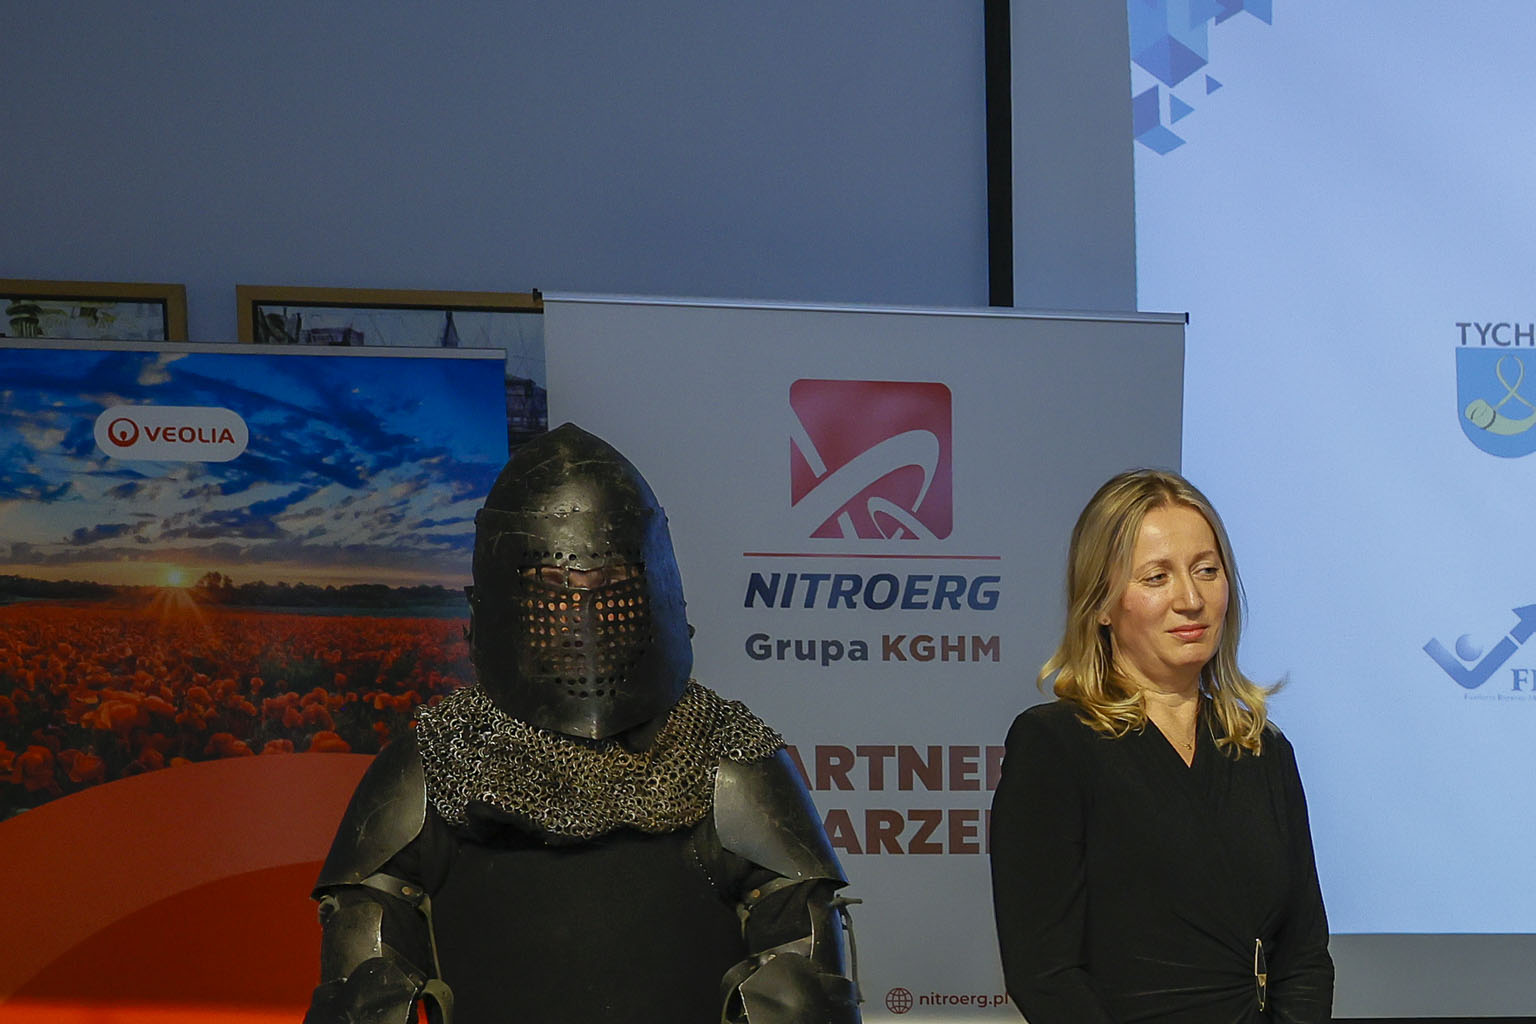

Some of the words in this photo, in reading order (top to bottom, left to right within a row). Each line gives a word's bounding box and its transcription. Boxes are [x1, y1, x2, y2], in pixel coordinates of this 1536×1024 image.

[144, 426, 235, 443] VEOLIA
[743, 572, 1001, 611] NITROERG
[745, 633, 869, 667] Grupa
[881, 634, 1000, 662] KGHM
[823, 809, 991, 855] ARZE
[919, 988, 1008, 1008] nitroerg.pl
